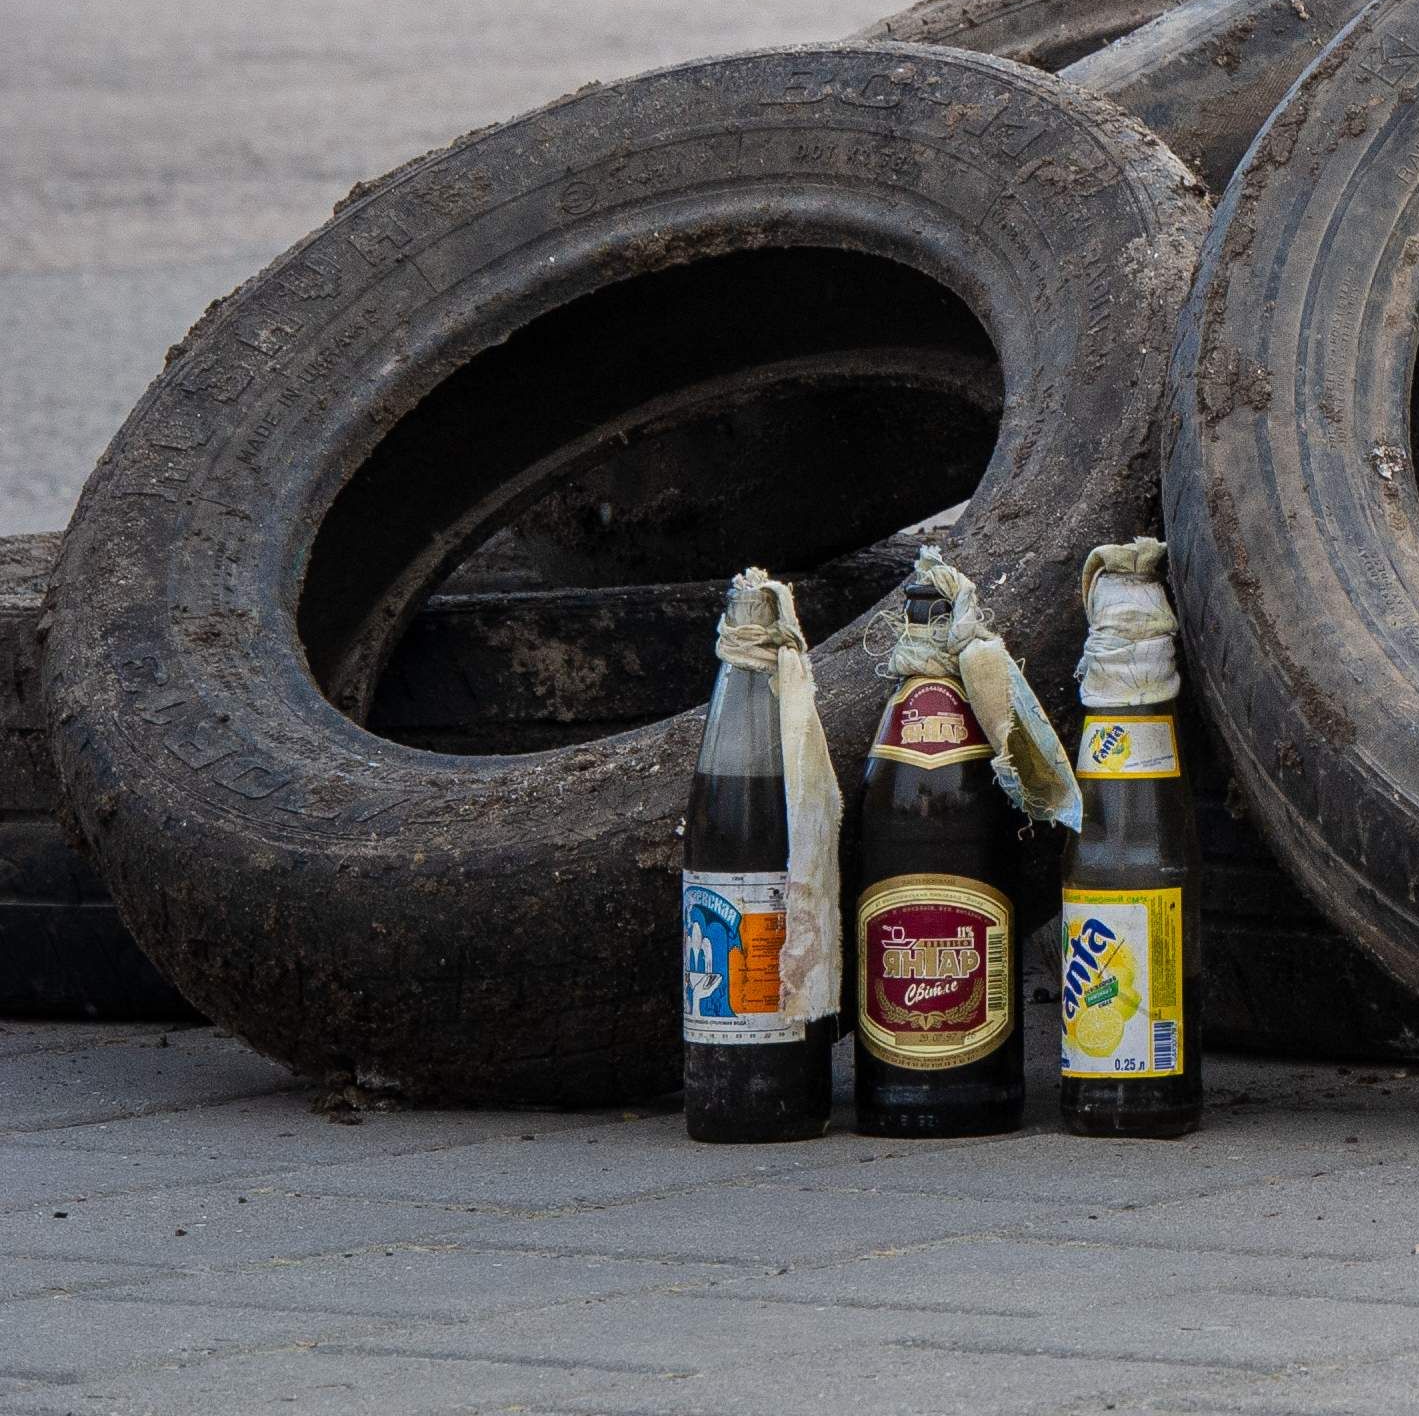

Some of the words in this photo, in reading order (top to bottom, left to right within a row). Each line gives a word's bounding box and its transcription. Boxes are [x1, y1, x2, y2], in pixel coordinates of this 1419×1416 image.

[237, 414, 280, 465] MADE
[277, 385, 304, 414] IN
[1092, 725, 1125, 764] Fanta
[957, 925, 975, 939] 11%
[882, 947, 980, 978] ЯНТАР
[1061, 918, 1117, 1036] anta
[904, 980, 959, 1006] Світле
